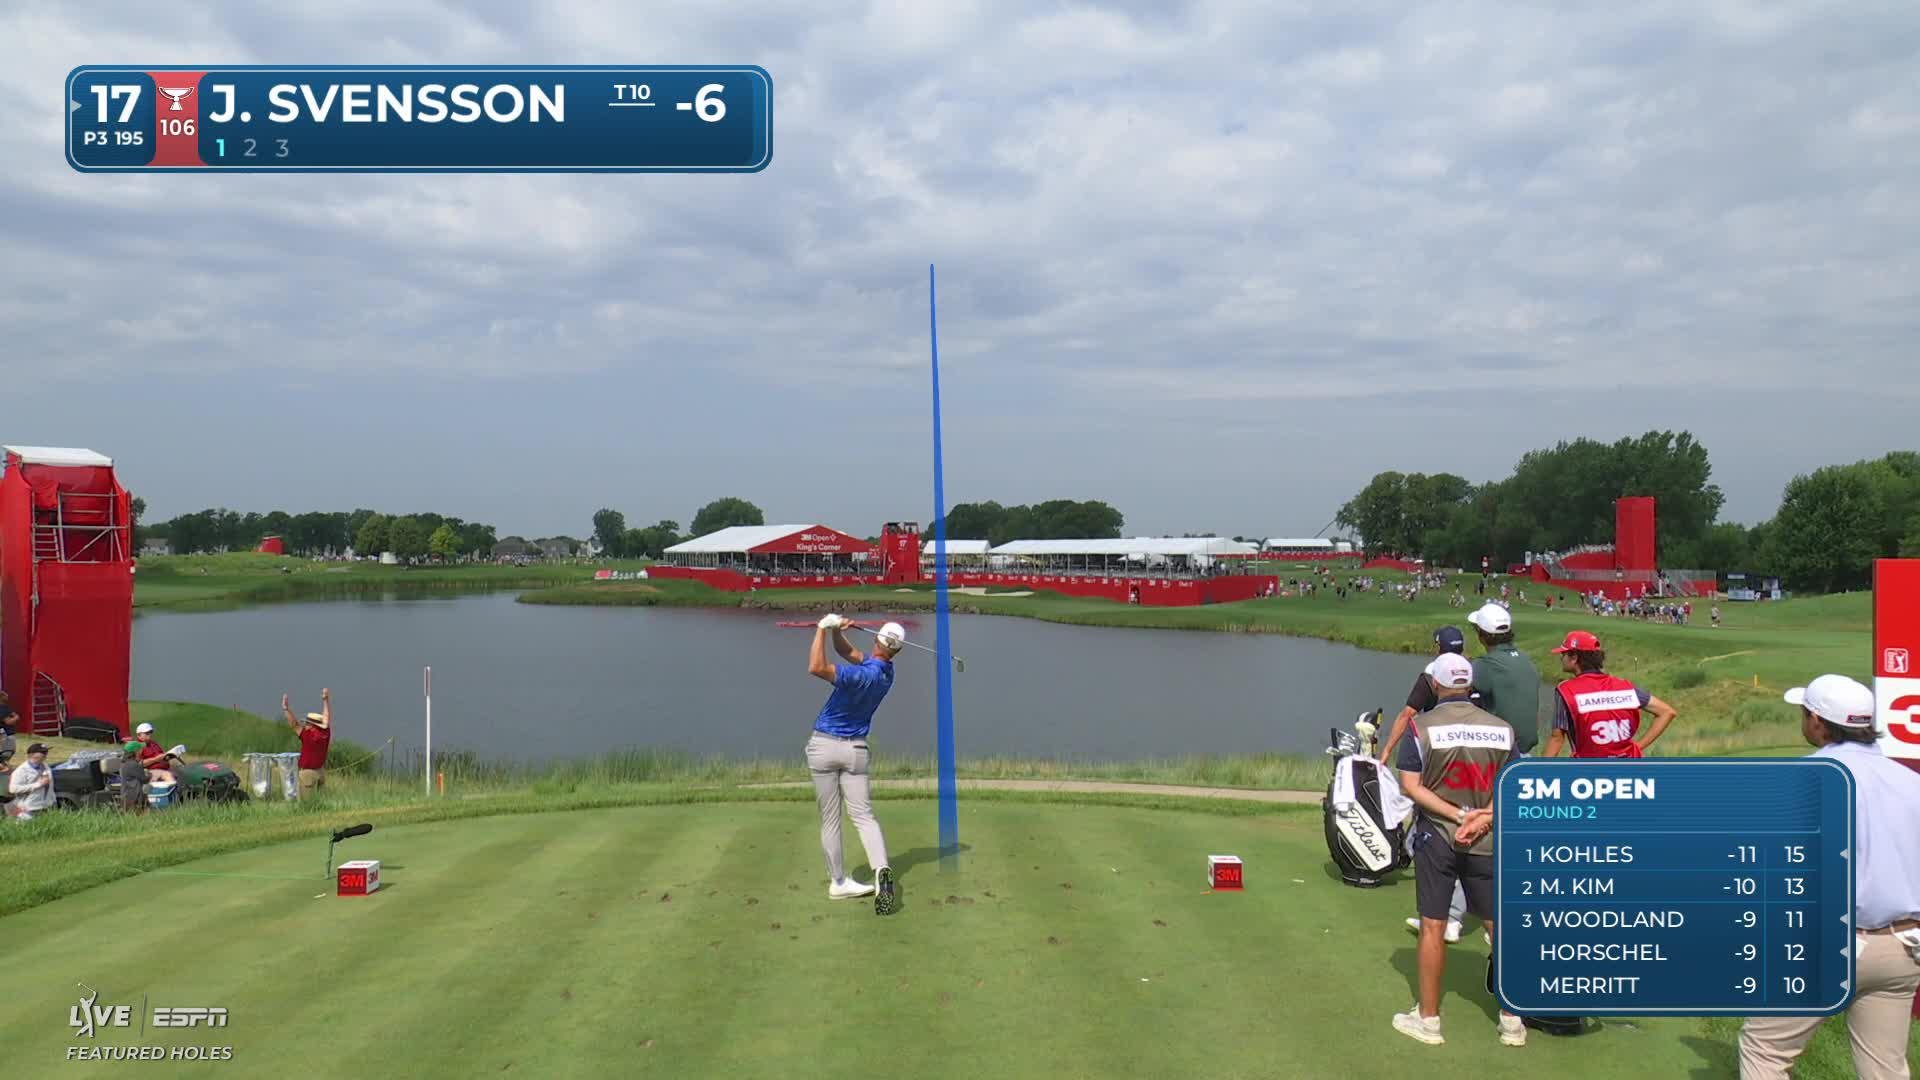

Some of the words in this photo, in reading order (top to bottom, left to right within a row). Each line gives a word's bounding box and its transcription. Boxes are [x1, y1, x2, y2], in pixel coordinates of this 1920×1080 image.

[813, 533, 829, 542] Open
[796, 542, 818, 552] King's
[818, 542, 842, 551] Corner
[1579, 694, 1634, 707] LAMPRECHT
[1447, 731, 1506, 743] SVENSSON
[1590, 718, 1632, 746] 3M
[1338, 806, 1387, 863] Titleist
[340, 873, 364, 887] 3M
[1215, 868, 1240, 881] 3M
